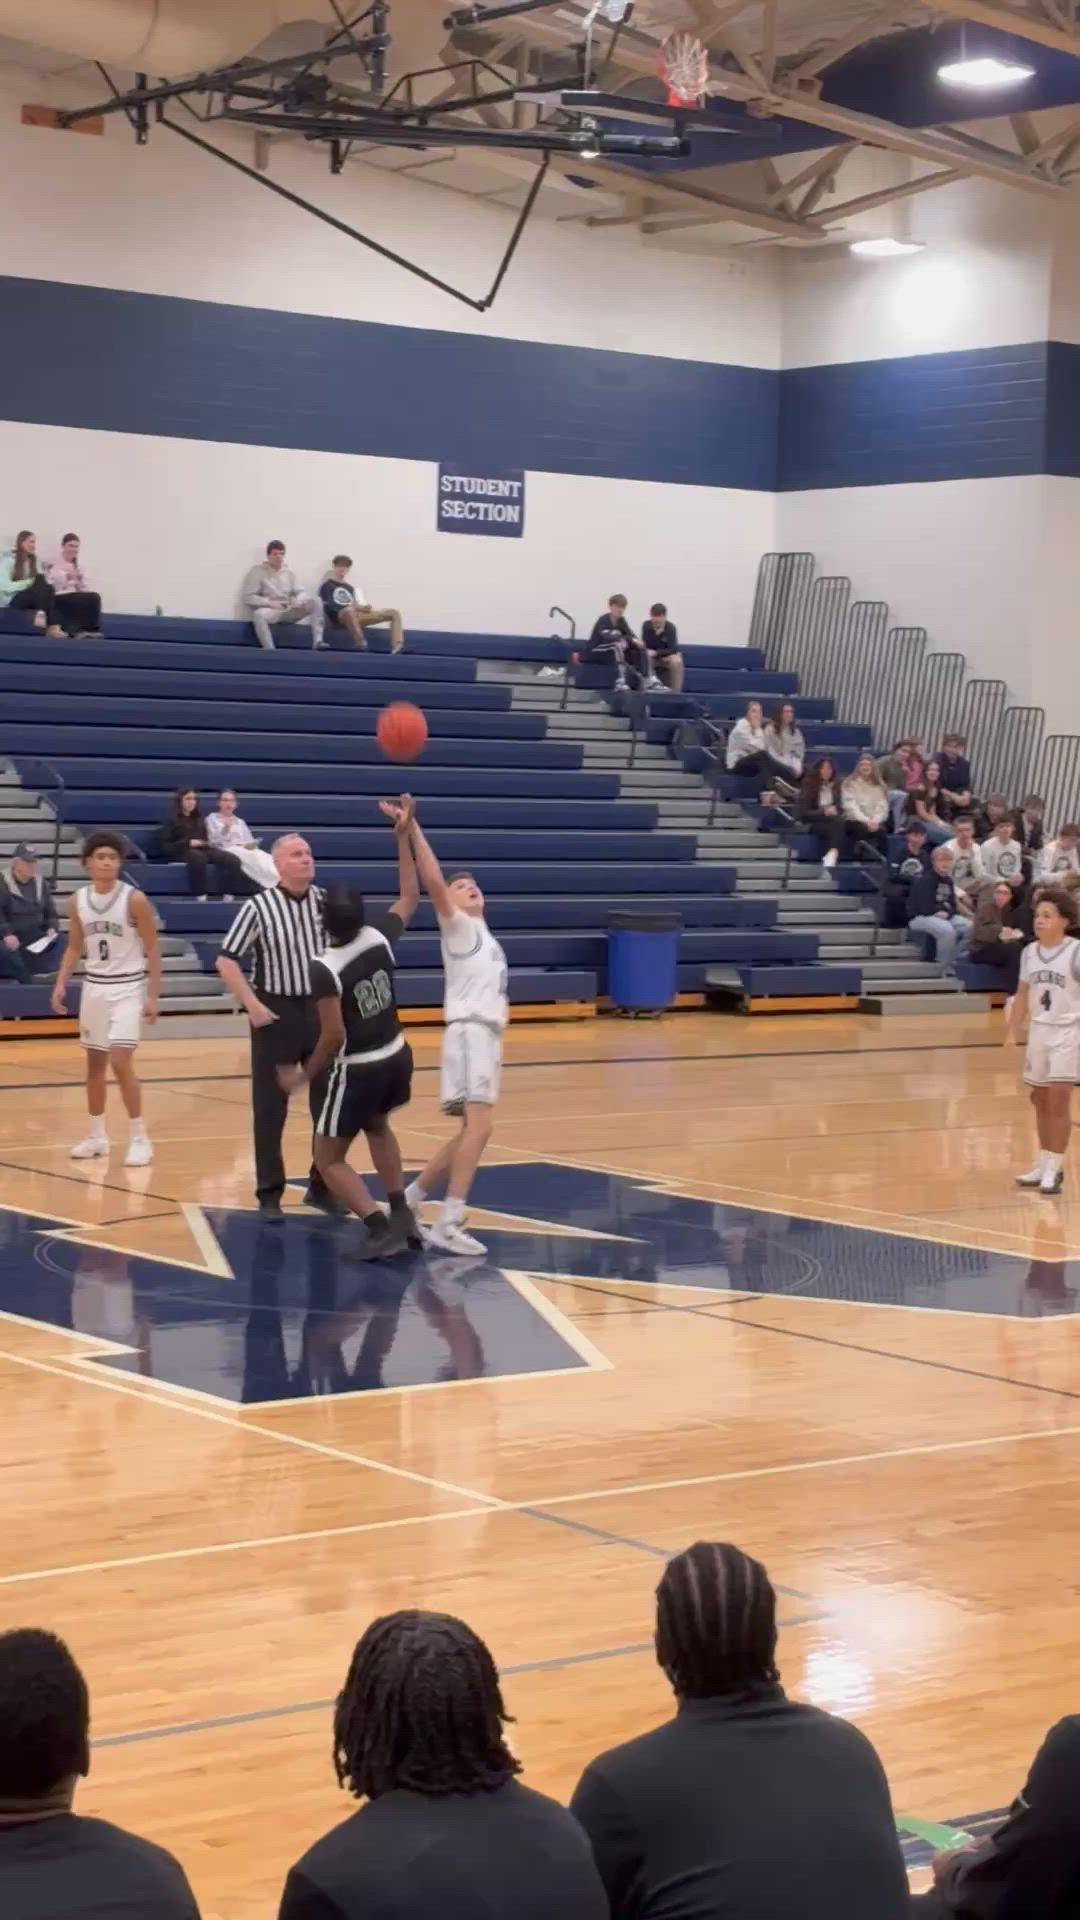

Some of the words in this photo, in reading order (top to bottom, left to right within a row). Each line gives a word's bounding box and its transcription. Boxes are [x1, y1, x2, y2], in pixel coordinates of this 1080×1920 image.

[441, 474, 522, 498] STUDENT
[441, 499, 521, 523] SECTION
[1040, 989, 1052, 1012] 4
